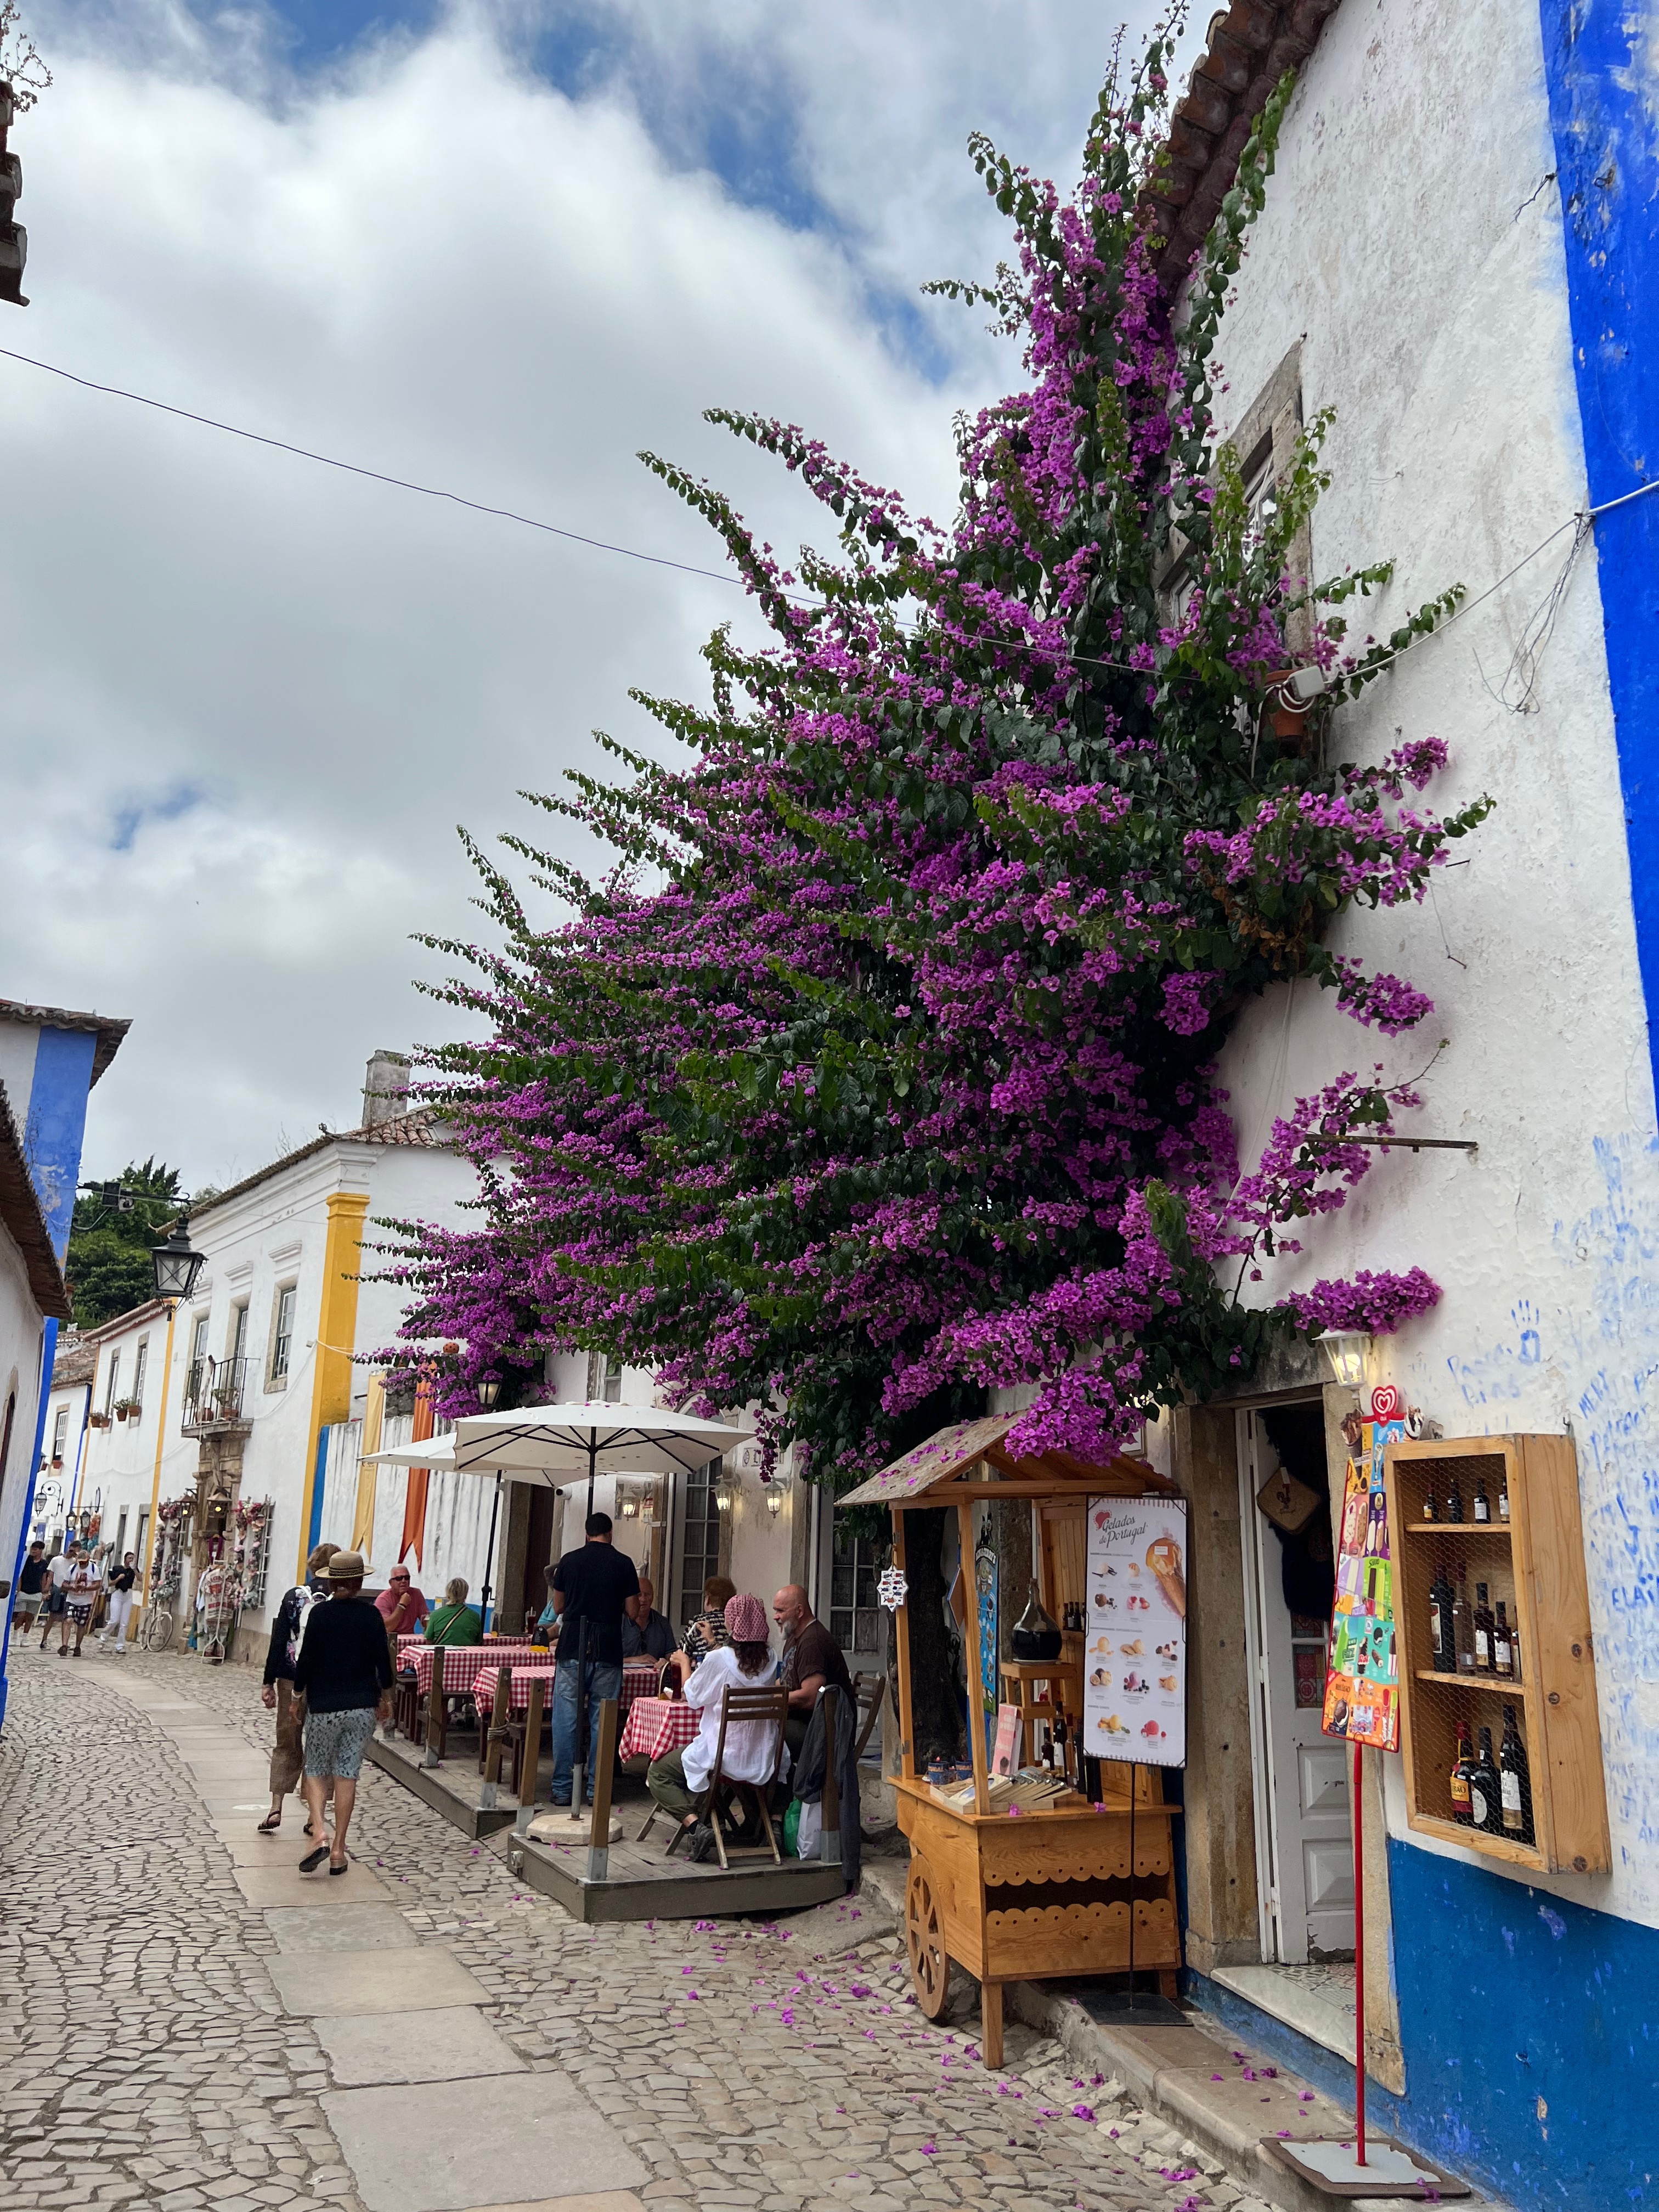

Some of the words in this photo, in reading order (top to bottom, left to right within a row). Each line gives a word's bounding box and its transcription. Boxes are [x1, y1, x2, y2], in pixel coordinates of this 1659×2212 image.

[1102, 1515, 1136, 1532] Gelados
[1099, 1534, 1107, 1544] de
[1107, 1522, 1147, 1548] Portugal
